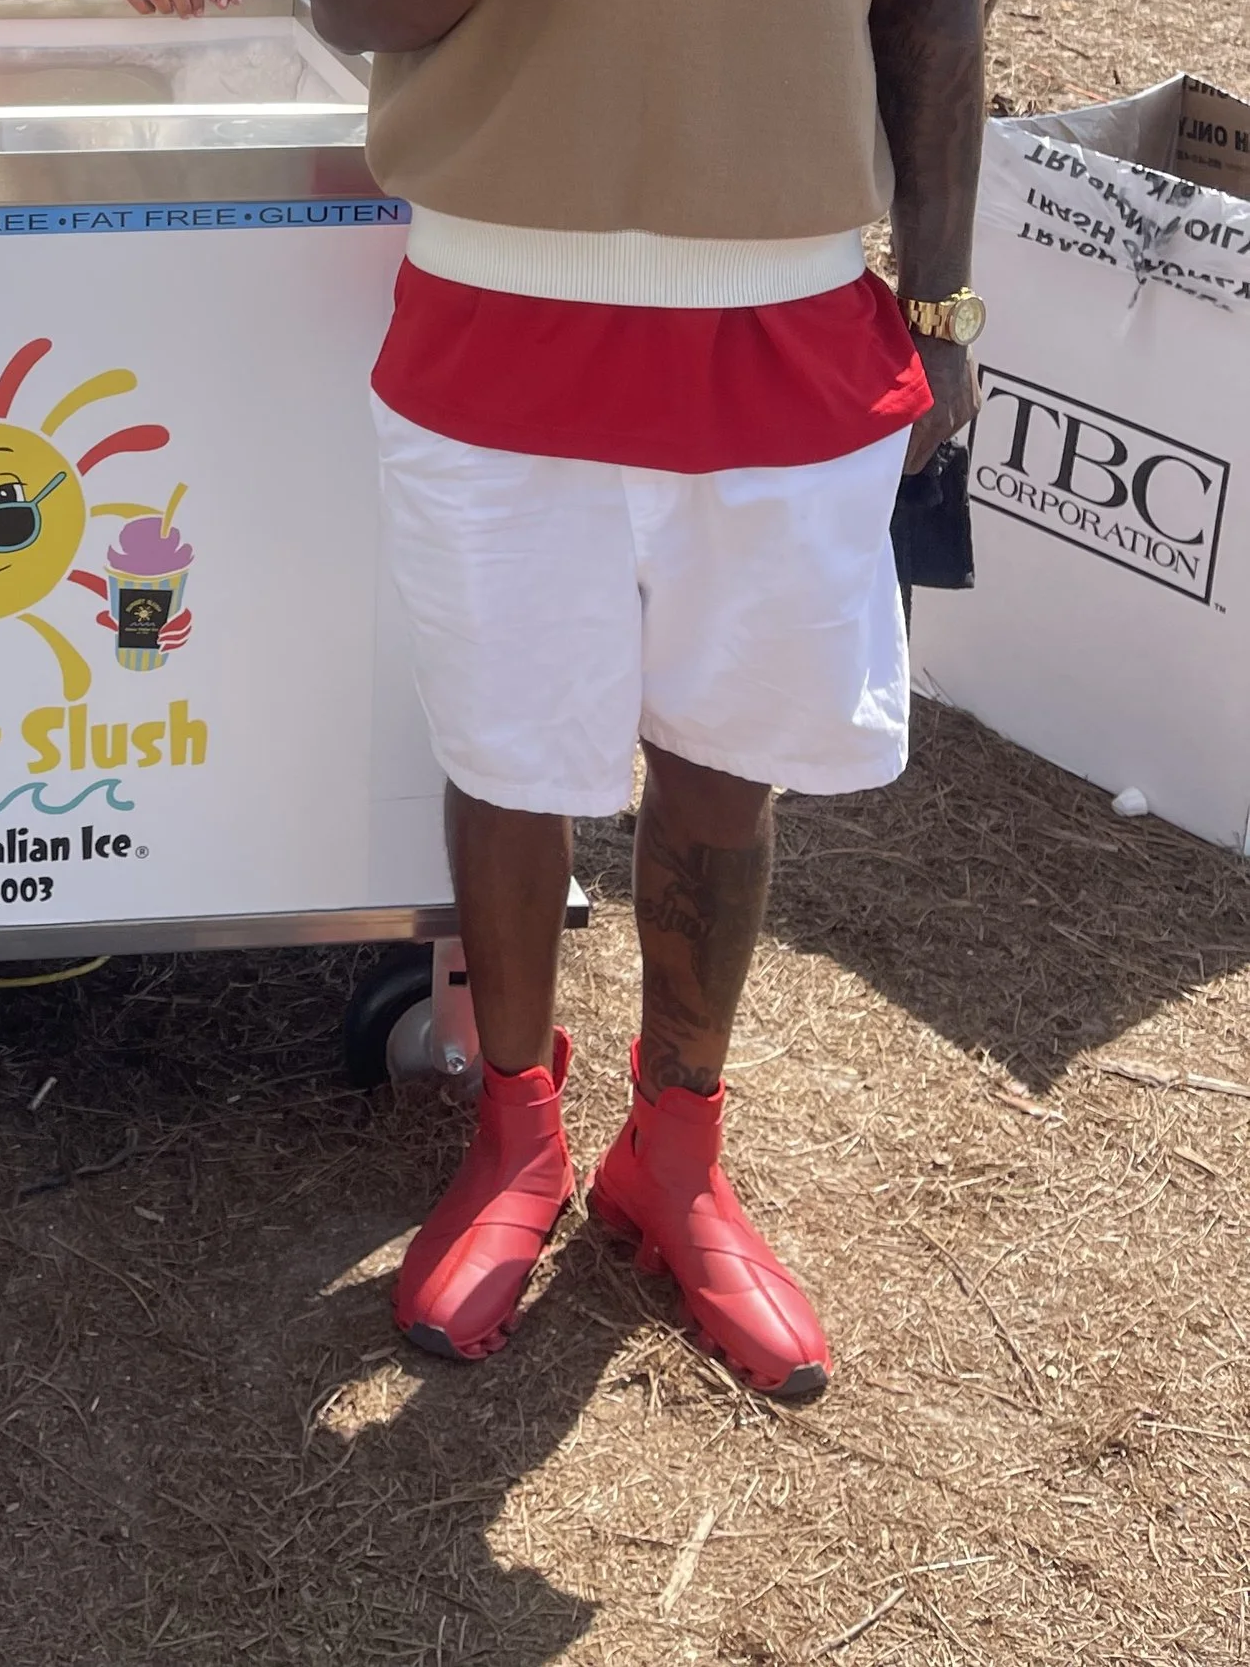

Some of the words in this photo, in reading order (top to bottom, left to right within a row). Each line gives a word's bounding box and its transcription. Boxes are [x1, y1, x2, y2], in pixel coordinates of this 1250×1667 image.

[72, 211, 133, 230] FAT
[145, 208, 237, 227] FREE
[259, 204, 399, 223] GLUTEN
[986, 386, 1213, 546] TBC
[976, 465, 1201, 581] CORPORATION
[21, 699, 208, 775] Slush
